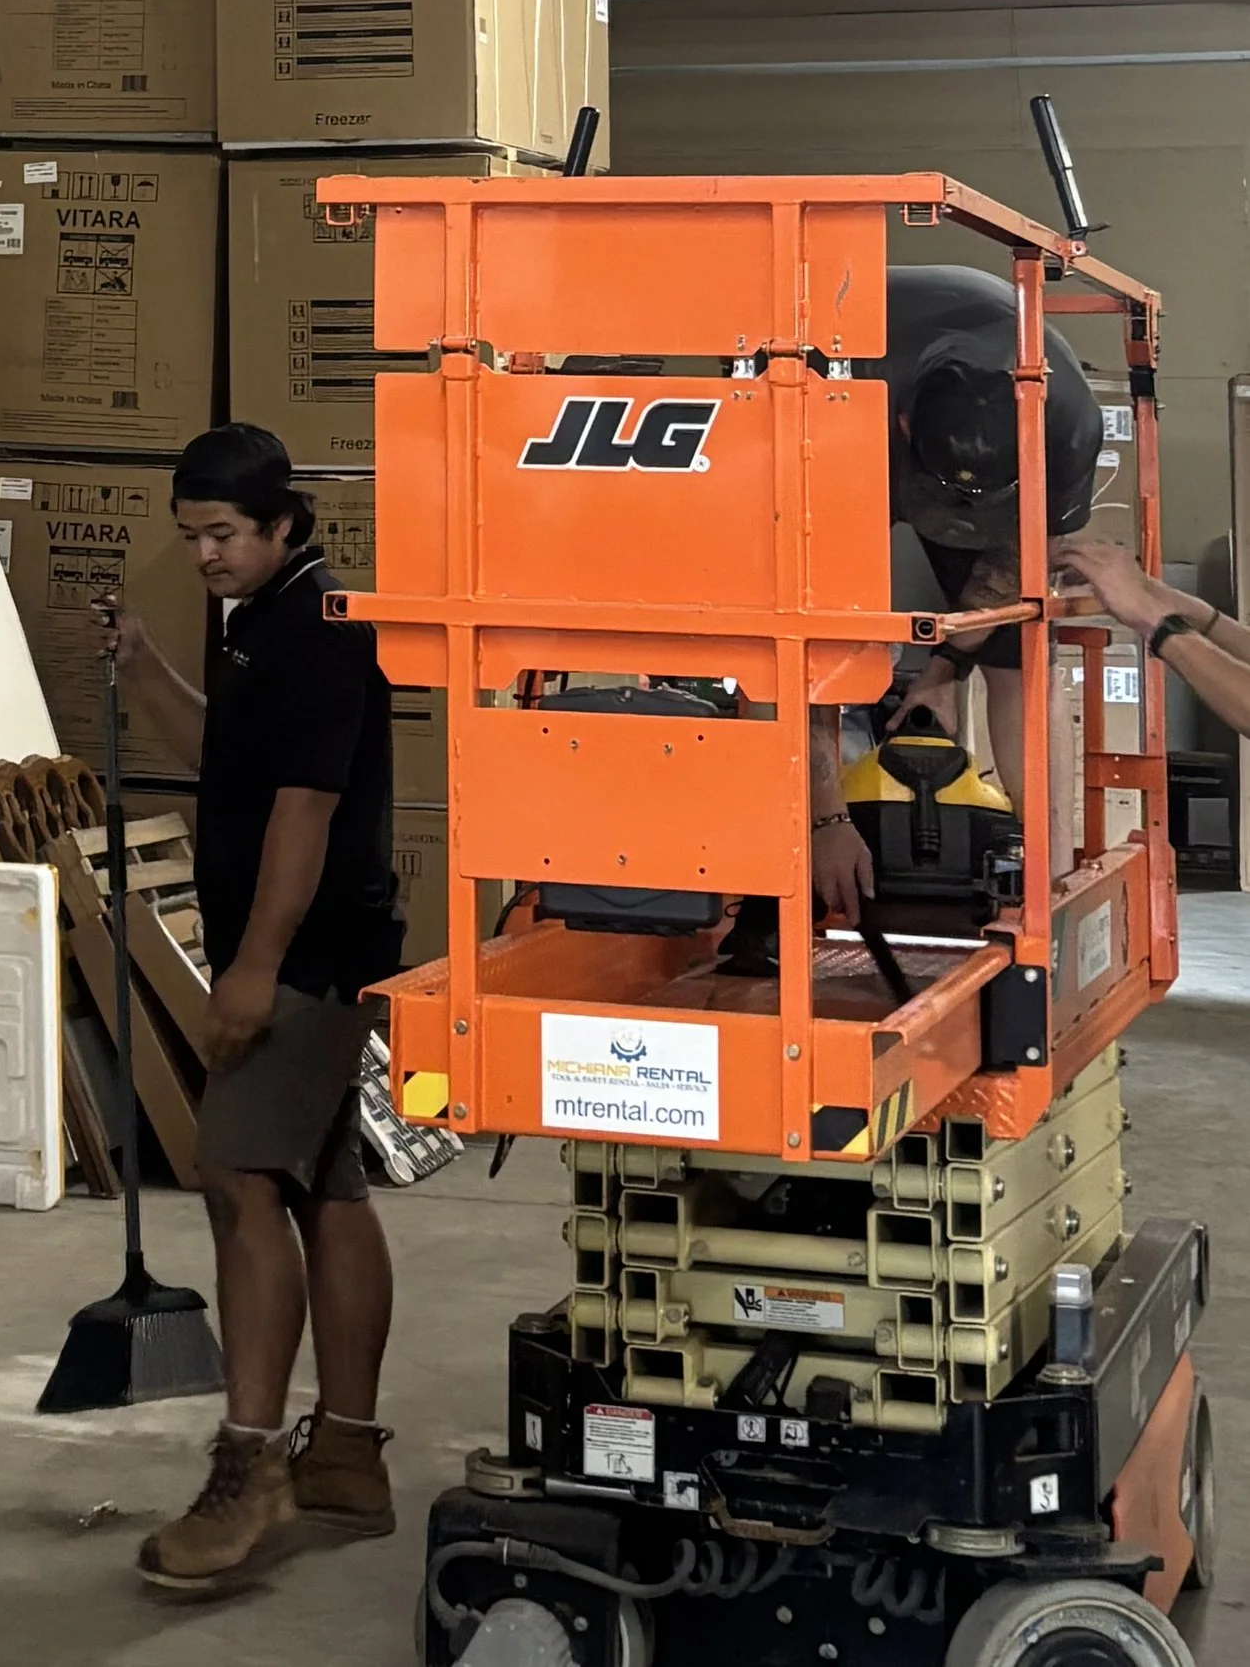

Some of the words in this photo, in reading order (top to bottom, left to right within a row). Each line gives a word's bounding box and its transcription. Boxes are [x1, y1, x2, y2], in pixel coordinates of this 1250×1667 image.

[314, 112, 373, 127] Freezer
[56, 208, 142, 229] VITARA
[330, 436, 374, 451] Freez
[519, 397, 720, 471] JLG
[46, 520, 132, 545] VITARA
[547, 1059, 631, 1078] MICHIANA
[636, 1066, 712, 1085] RENTAL
[555, 1096, 705, 1127] mtrental.com
